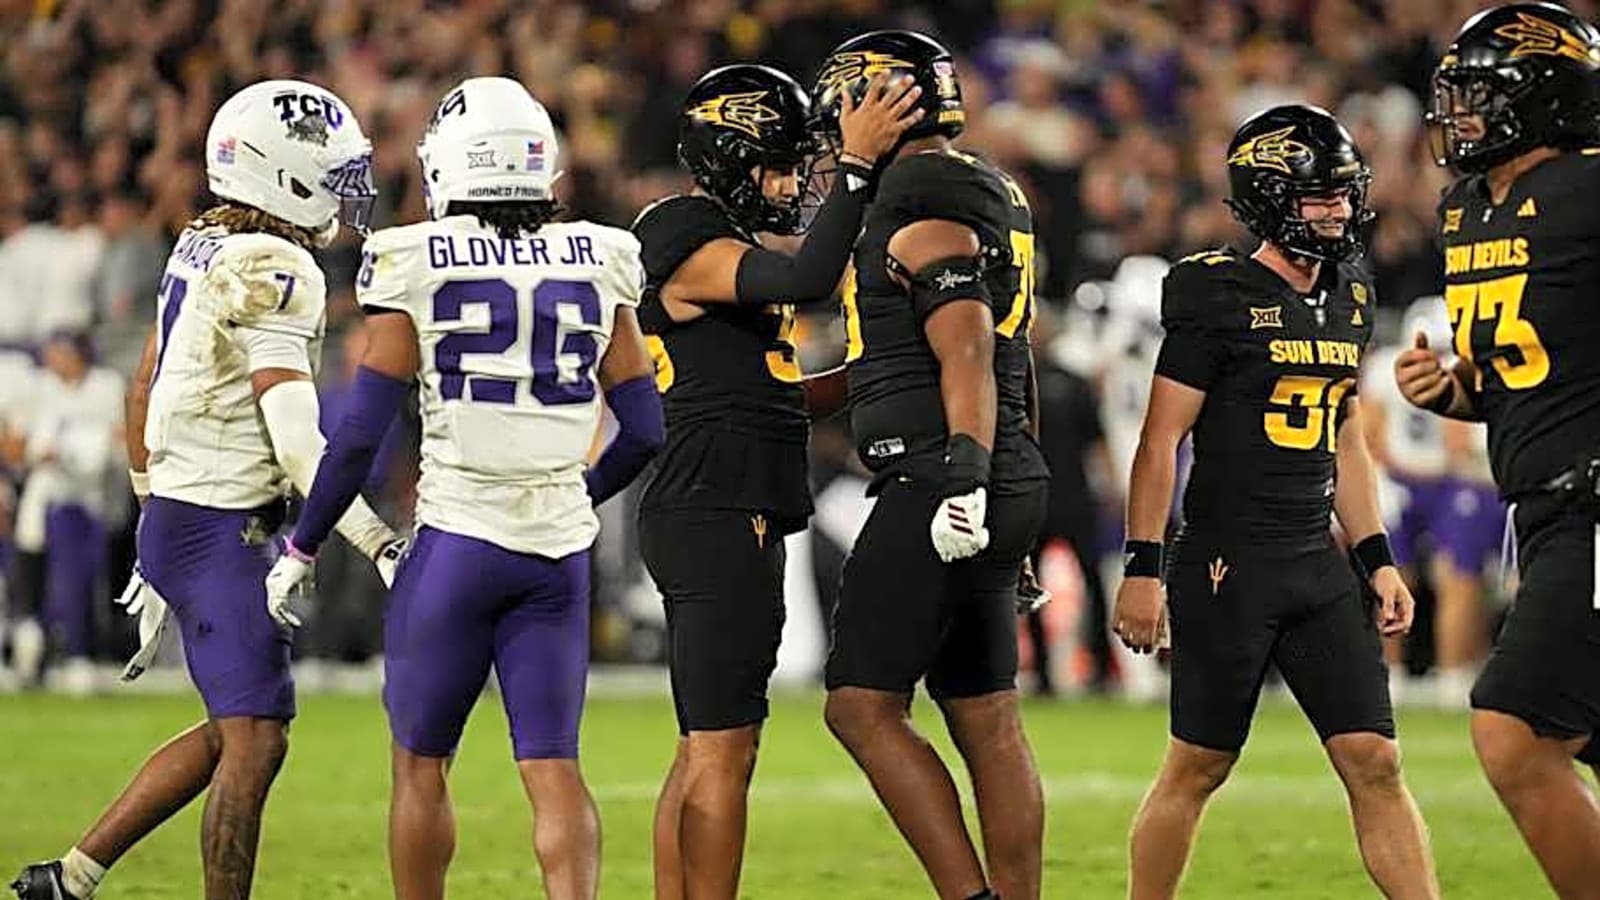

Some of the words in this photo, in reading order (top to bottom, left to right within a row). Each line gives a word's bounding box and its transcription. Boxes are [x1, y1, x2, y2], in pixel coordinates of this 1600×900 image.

[273, 94, 343, 131] TCU
[428, 235, 551, 269] GLOVER
[560, 235, 604, 266] JR.
[1473, 237, 1530, 270] DEVILS
[274, 272, 297, 311] 7
[432, 278, 601, 406] 26
[1445, 272, 1550, 392] 73
[1269, 338, 1314, 364] SUN
